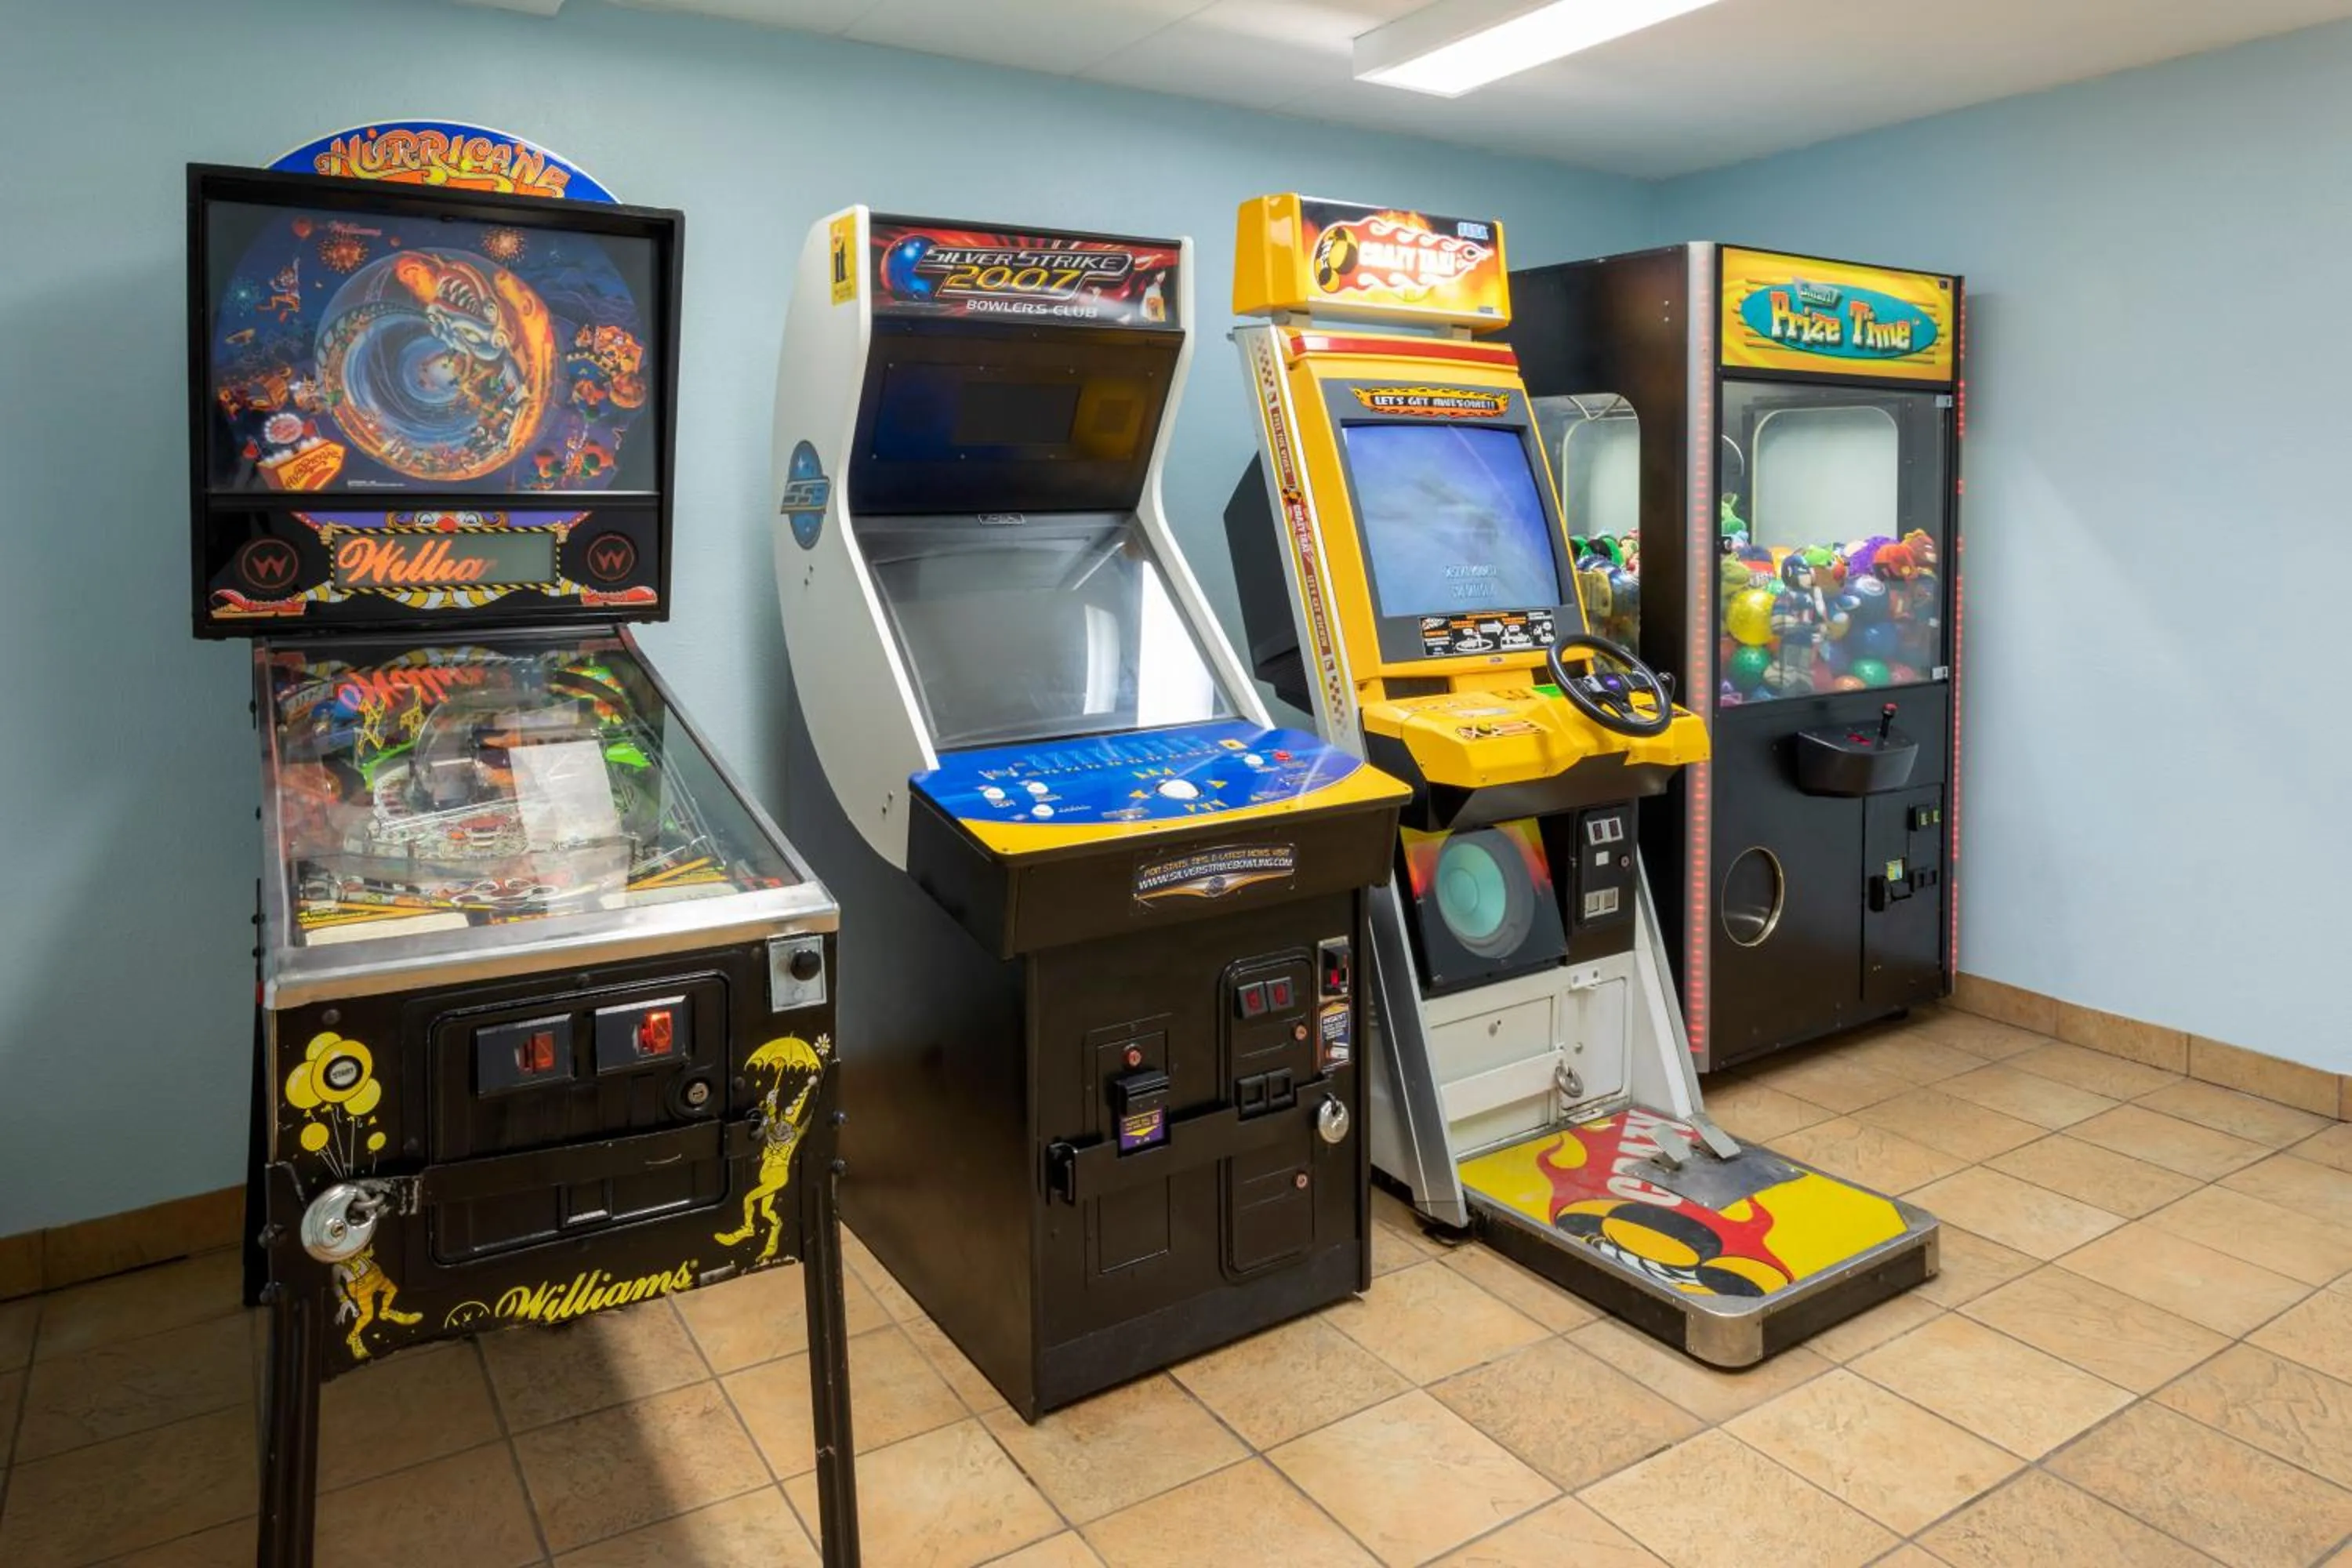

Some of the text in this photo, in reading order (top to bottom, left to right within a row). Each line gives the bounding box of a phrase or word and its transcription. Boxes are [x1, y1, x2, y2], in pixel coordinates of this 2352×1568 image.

[314, 127, 570, 198] HURRICANE
[926, 245, 1123, 270] SILVER STRIKE
[1359, 241, 1456, 276] CRAZY TAXI
[944, 264, 1082, 291] 2007
[966, 299, 1098, 318] BOWLERS CLUB
[1769, 291, 1911, 350] Prize Time
[1374, 395, 1404, 405] LET'S
[1408, 397, 1429, 406] GET
[495, 1259, 695, 1325] Williams
